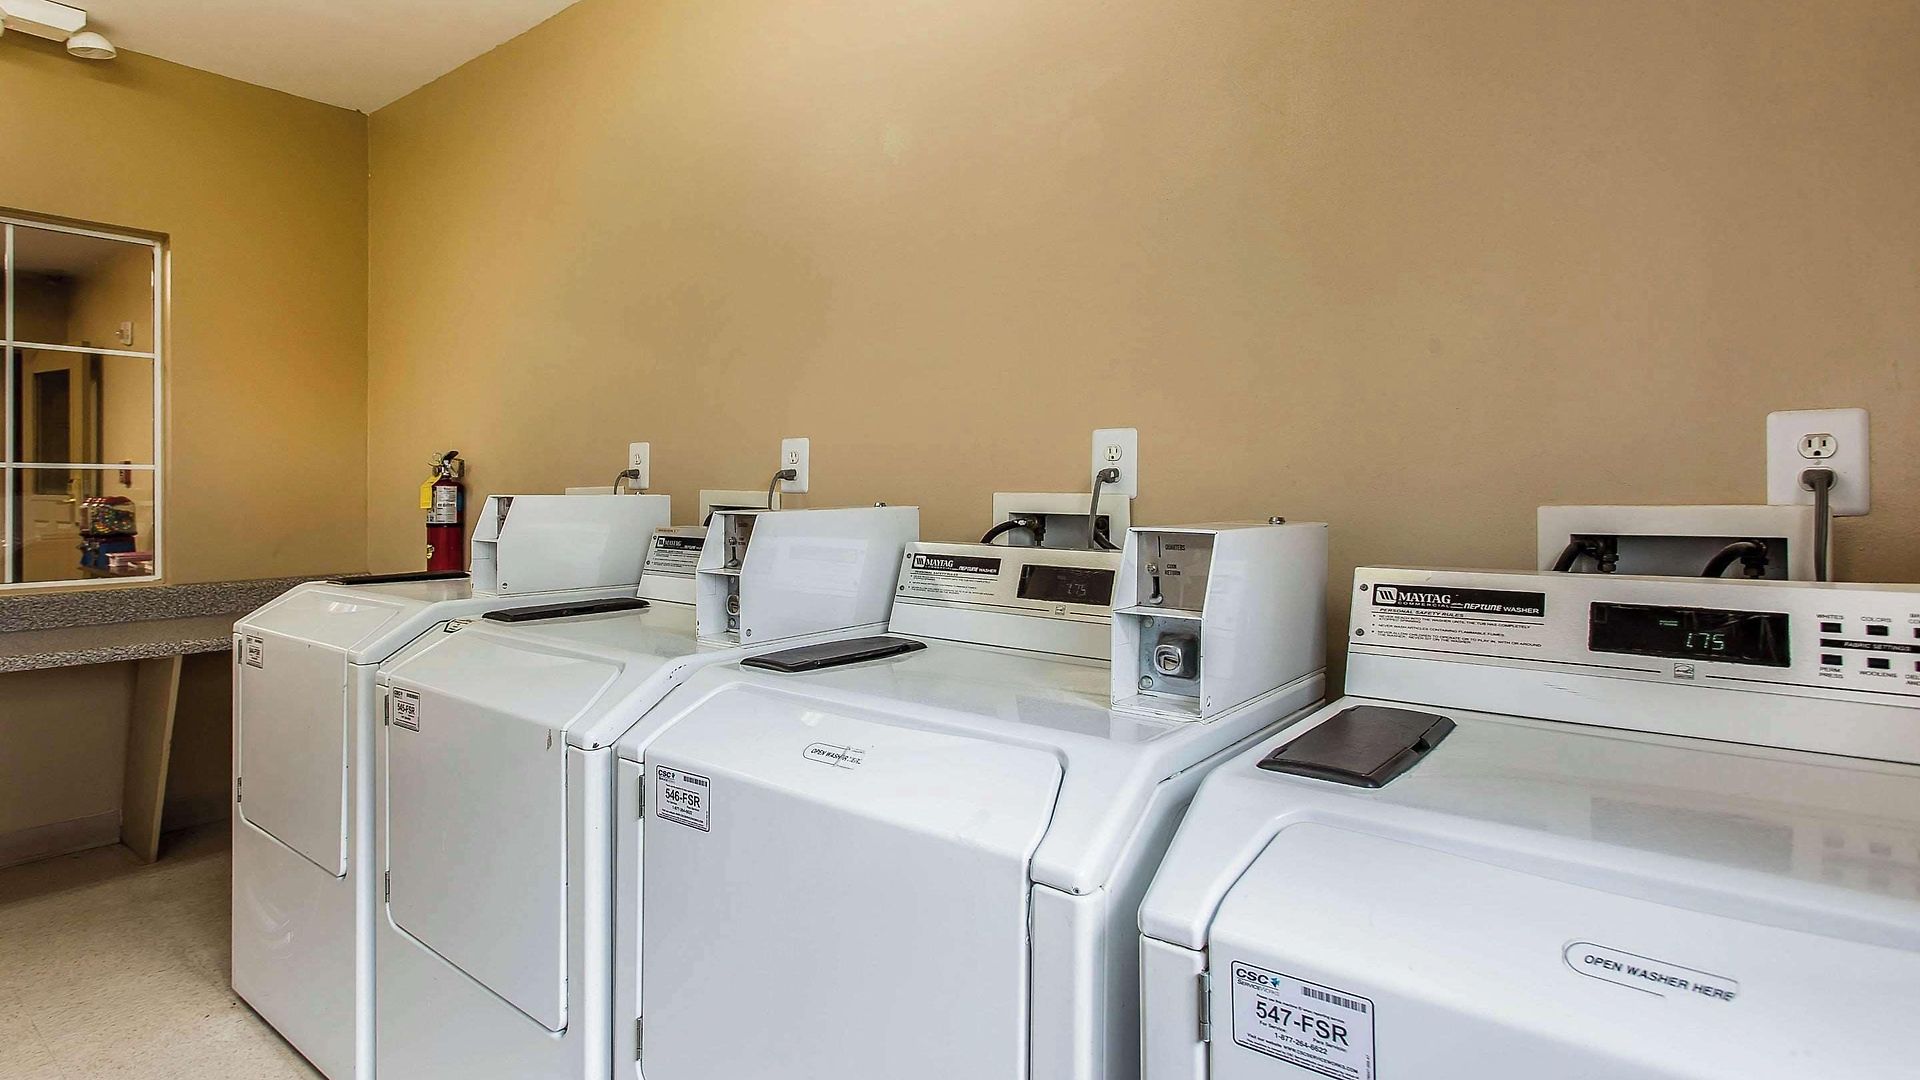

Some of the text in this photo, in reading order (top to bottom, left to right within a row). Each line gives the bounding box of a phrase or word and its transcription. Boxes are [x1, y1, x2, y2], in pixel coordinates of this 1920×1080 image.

[925, 558, 954, 568] MAYTAG
[978, 567, 998, 575] WASHER
[1398, 591, 1452, 605] MAYTAG
[1397, 601, 1540, 614] COMMERCIAL NEPTUNE WASHER
[1842, 641, 1911, 653] FABRIC SETTINGS
[658, 769, 672, 778] CSC
[665, 788, 701, 809] 546-FSR
[1236, 968, 1270, 985] CSC
[1584, 954, 1737, 1002] OPEN WASHER HERE
[1255, 1000, 1350, 1047] 547-FSR
